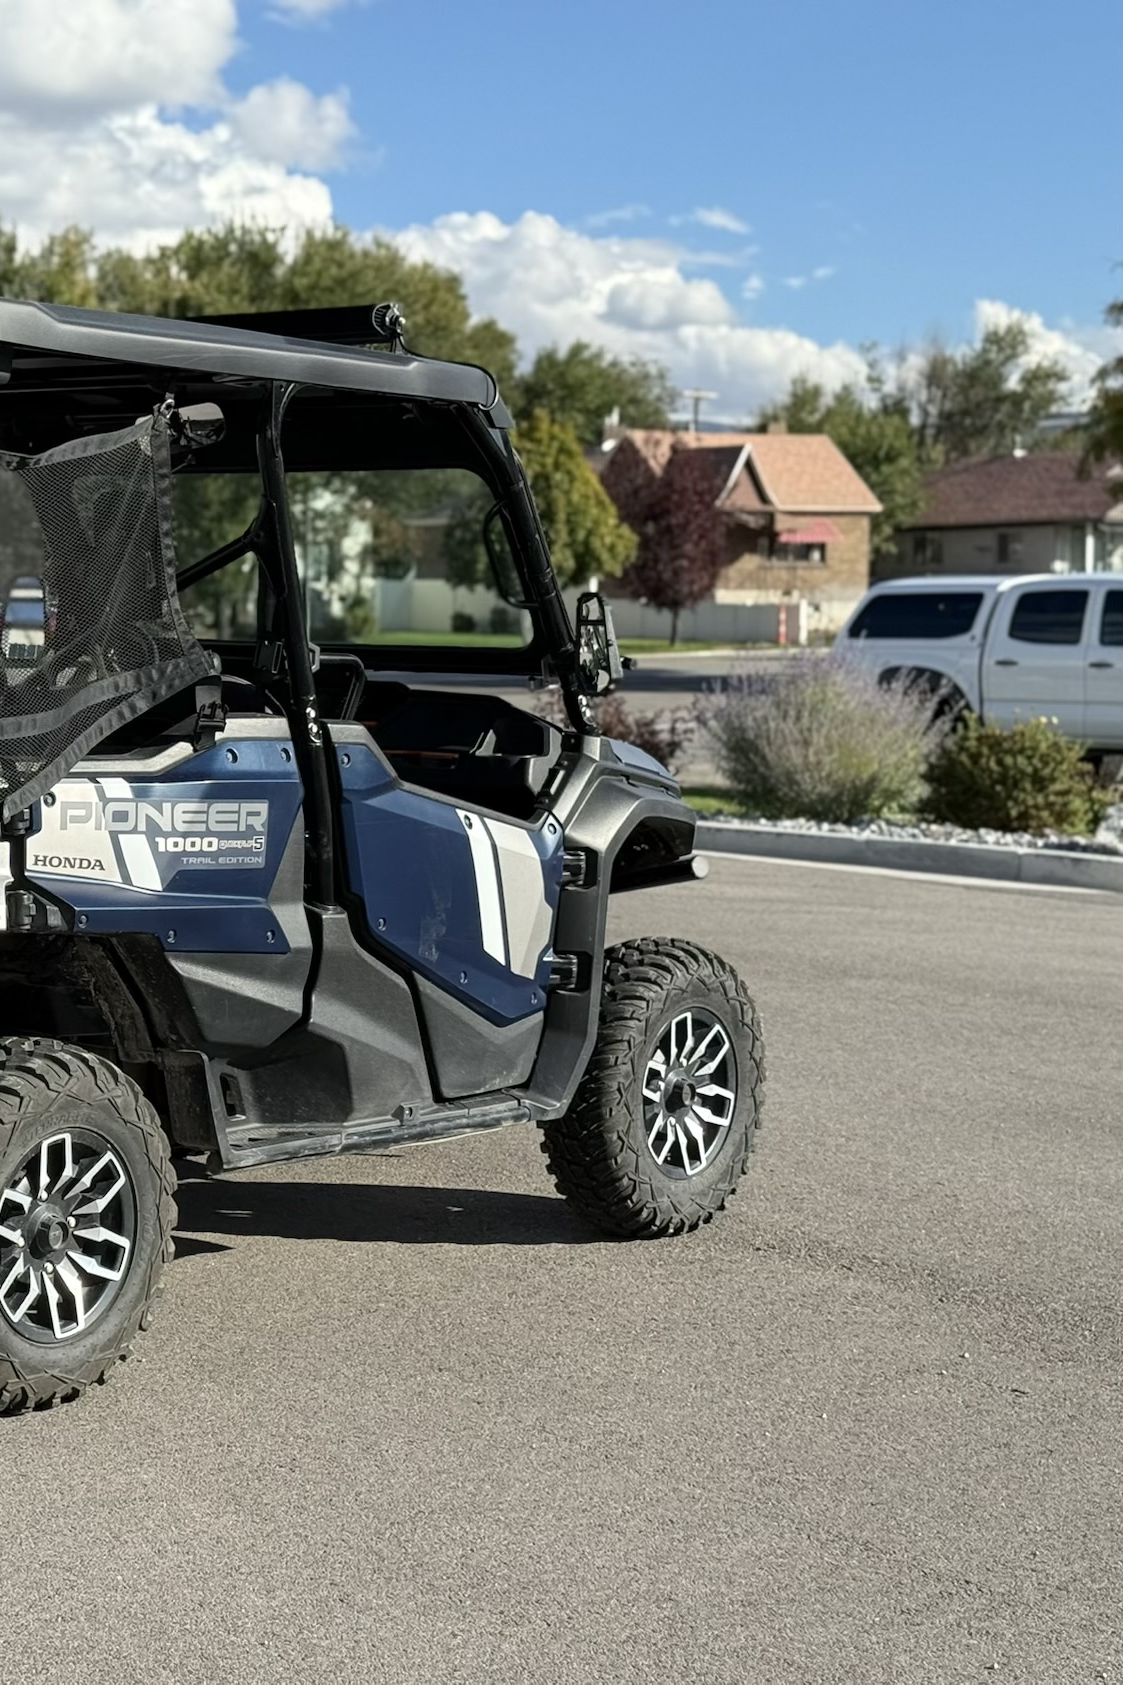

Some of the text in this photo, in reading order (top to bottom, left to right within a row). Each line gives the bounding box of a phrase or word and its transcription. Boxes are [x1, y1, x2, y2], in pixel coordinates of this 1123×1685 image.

[60, 801, 264, 831] PIONEER
[154, 836, 219, 853] 1000
[32, 854, 106, 872] HONDA
[180, 856, 263, 865] TRAIL EDITION
